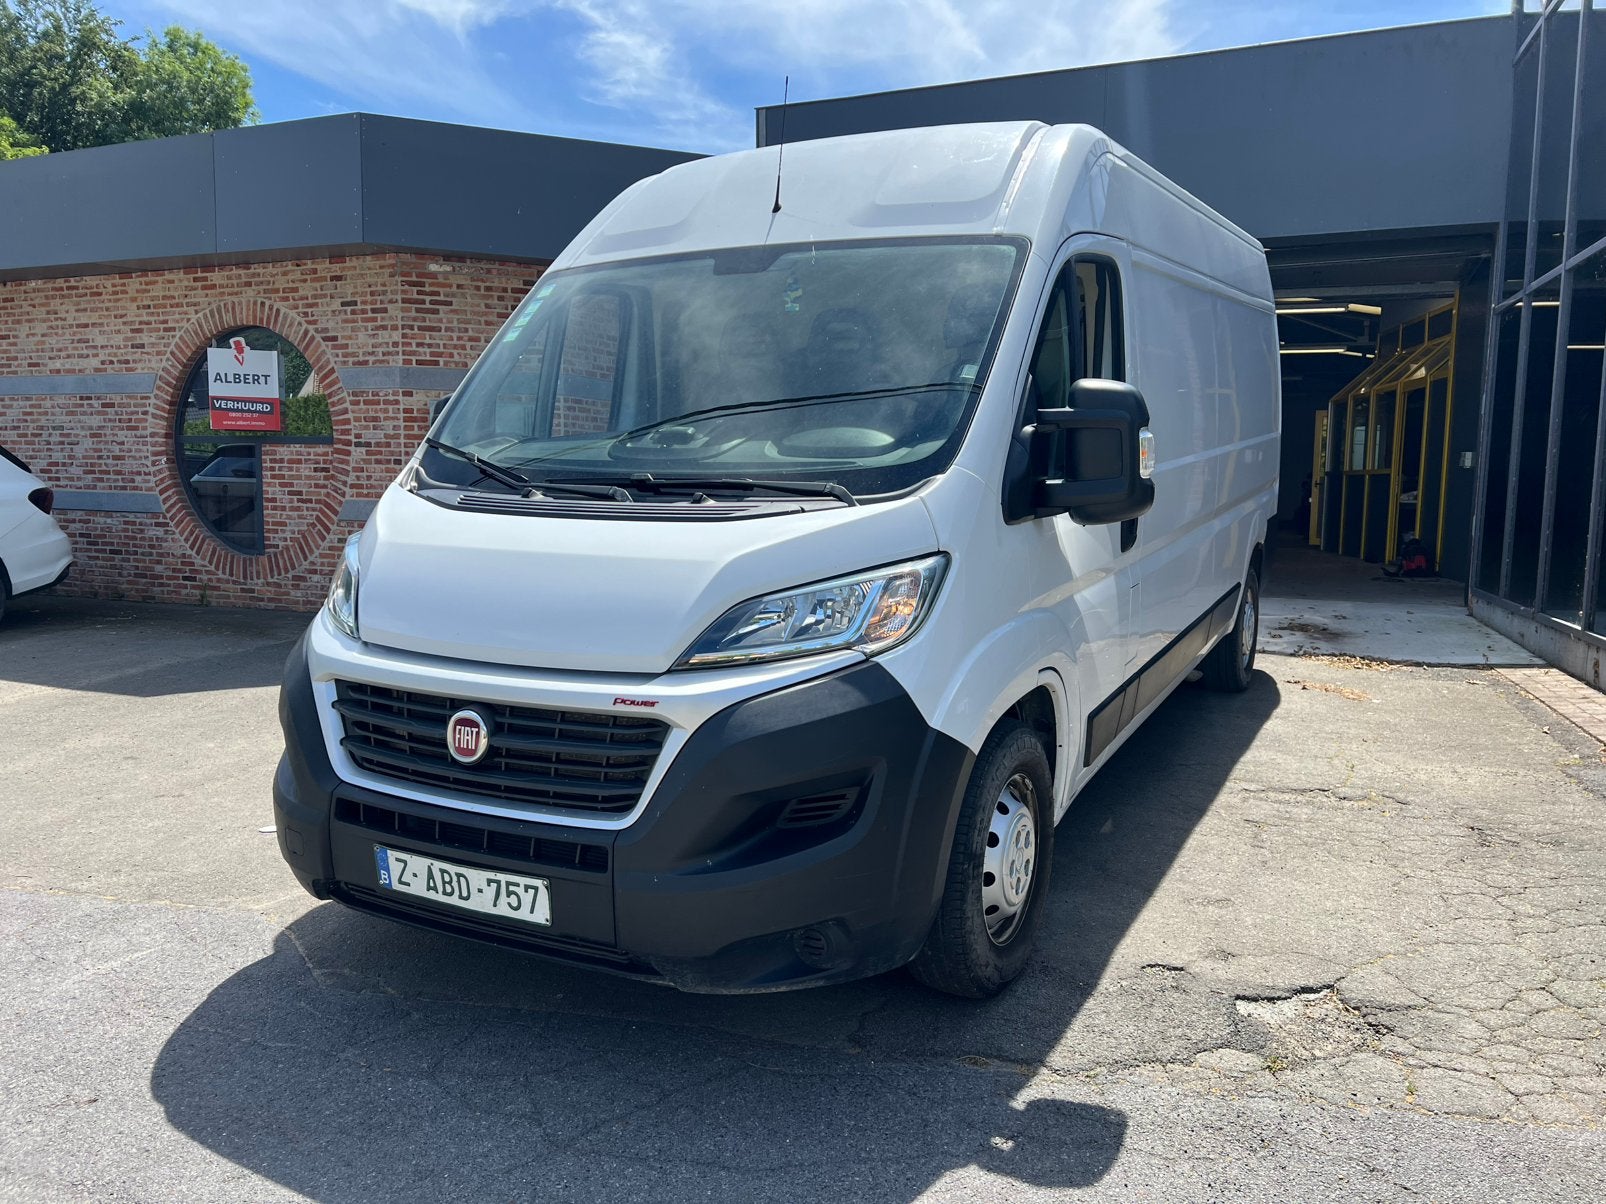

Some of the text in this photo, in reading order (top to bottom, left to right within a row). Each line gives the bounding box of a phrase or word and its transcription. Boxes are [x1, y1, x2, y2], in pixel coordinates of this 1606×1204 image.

[213, 372, 271, 385] ALBERT
[213, 399, 271, 412] VERHUURD
[455, 725, 479, 750] FIAT
[380, 870, 389, 884] B
